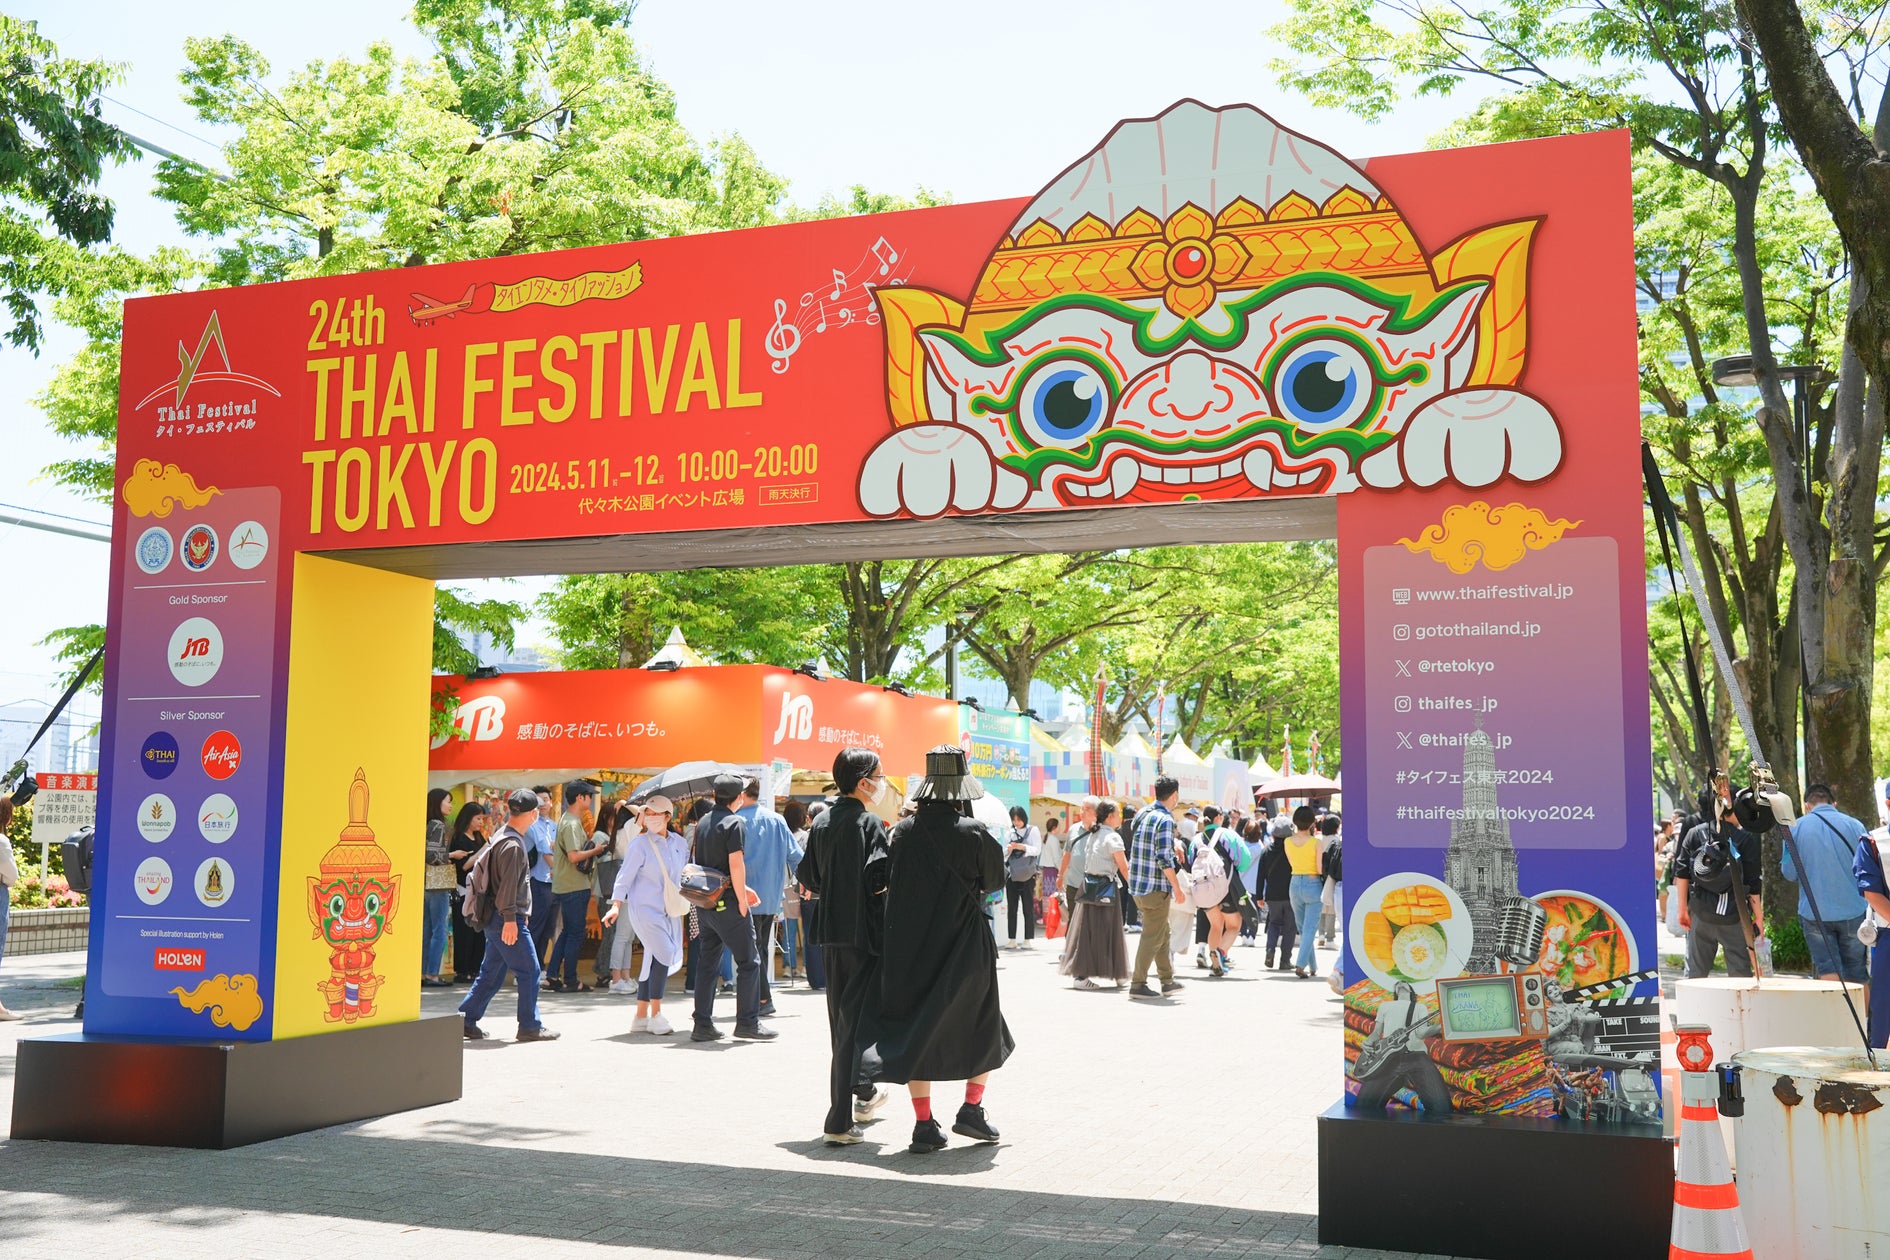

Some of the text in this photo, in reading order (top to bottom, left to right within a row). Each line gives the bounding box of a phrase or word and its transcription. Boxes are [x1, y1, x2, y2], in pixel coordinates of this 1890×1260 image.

[497, 271, 634, 307] タイエンタメ・タイファッション
[308, 295, 384, 352] 24th
[306, 318, 762, 441] THAI FESTIVAL
[158, 399, 257, 421] Thai Festival
[302, 438, 498, 535] TOKYO
[769, 487, 811, 501] 雨天決行
[578, 489, 745, 514] 代々木公園イベント広場
[168, 595, 228, 605] Gold Sponsor
[1417, 583, 1573, 601] www.thaifestival.jp
[1416, 621, 1541, 640] gotothailand.jp
[180, 638, 210, 660] JTB
[1418, 659, 1495, 675] @rtetokyo
[1418, 696, 1498, 712] thaifes_jp
[160, 710, 225, 721] Silver Sponsor
[773, 691, 813, 745] JTB
[516, 720, 666, 741] 感動のそばに、いつも。
[818, 725, 884, 748] 感動のそばに、いつも。
[1419, 733, 1512, 749] @thaifes_jp
[155, 750, 176, 759] THAI
[1396, 769, 1554, 785] #タイフェス東京2024
[47, 793, 96, 803] 公園内では、
[1396, 806, 1595, 822] #thaifestivaltokyo2024
[140, 929, 158, 938] Special
[202, 932, 209, 940] by
[1606, 1017, 1623, 1026] TAKE
[1640, 1015, 1660, 1024] SOUN
